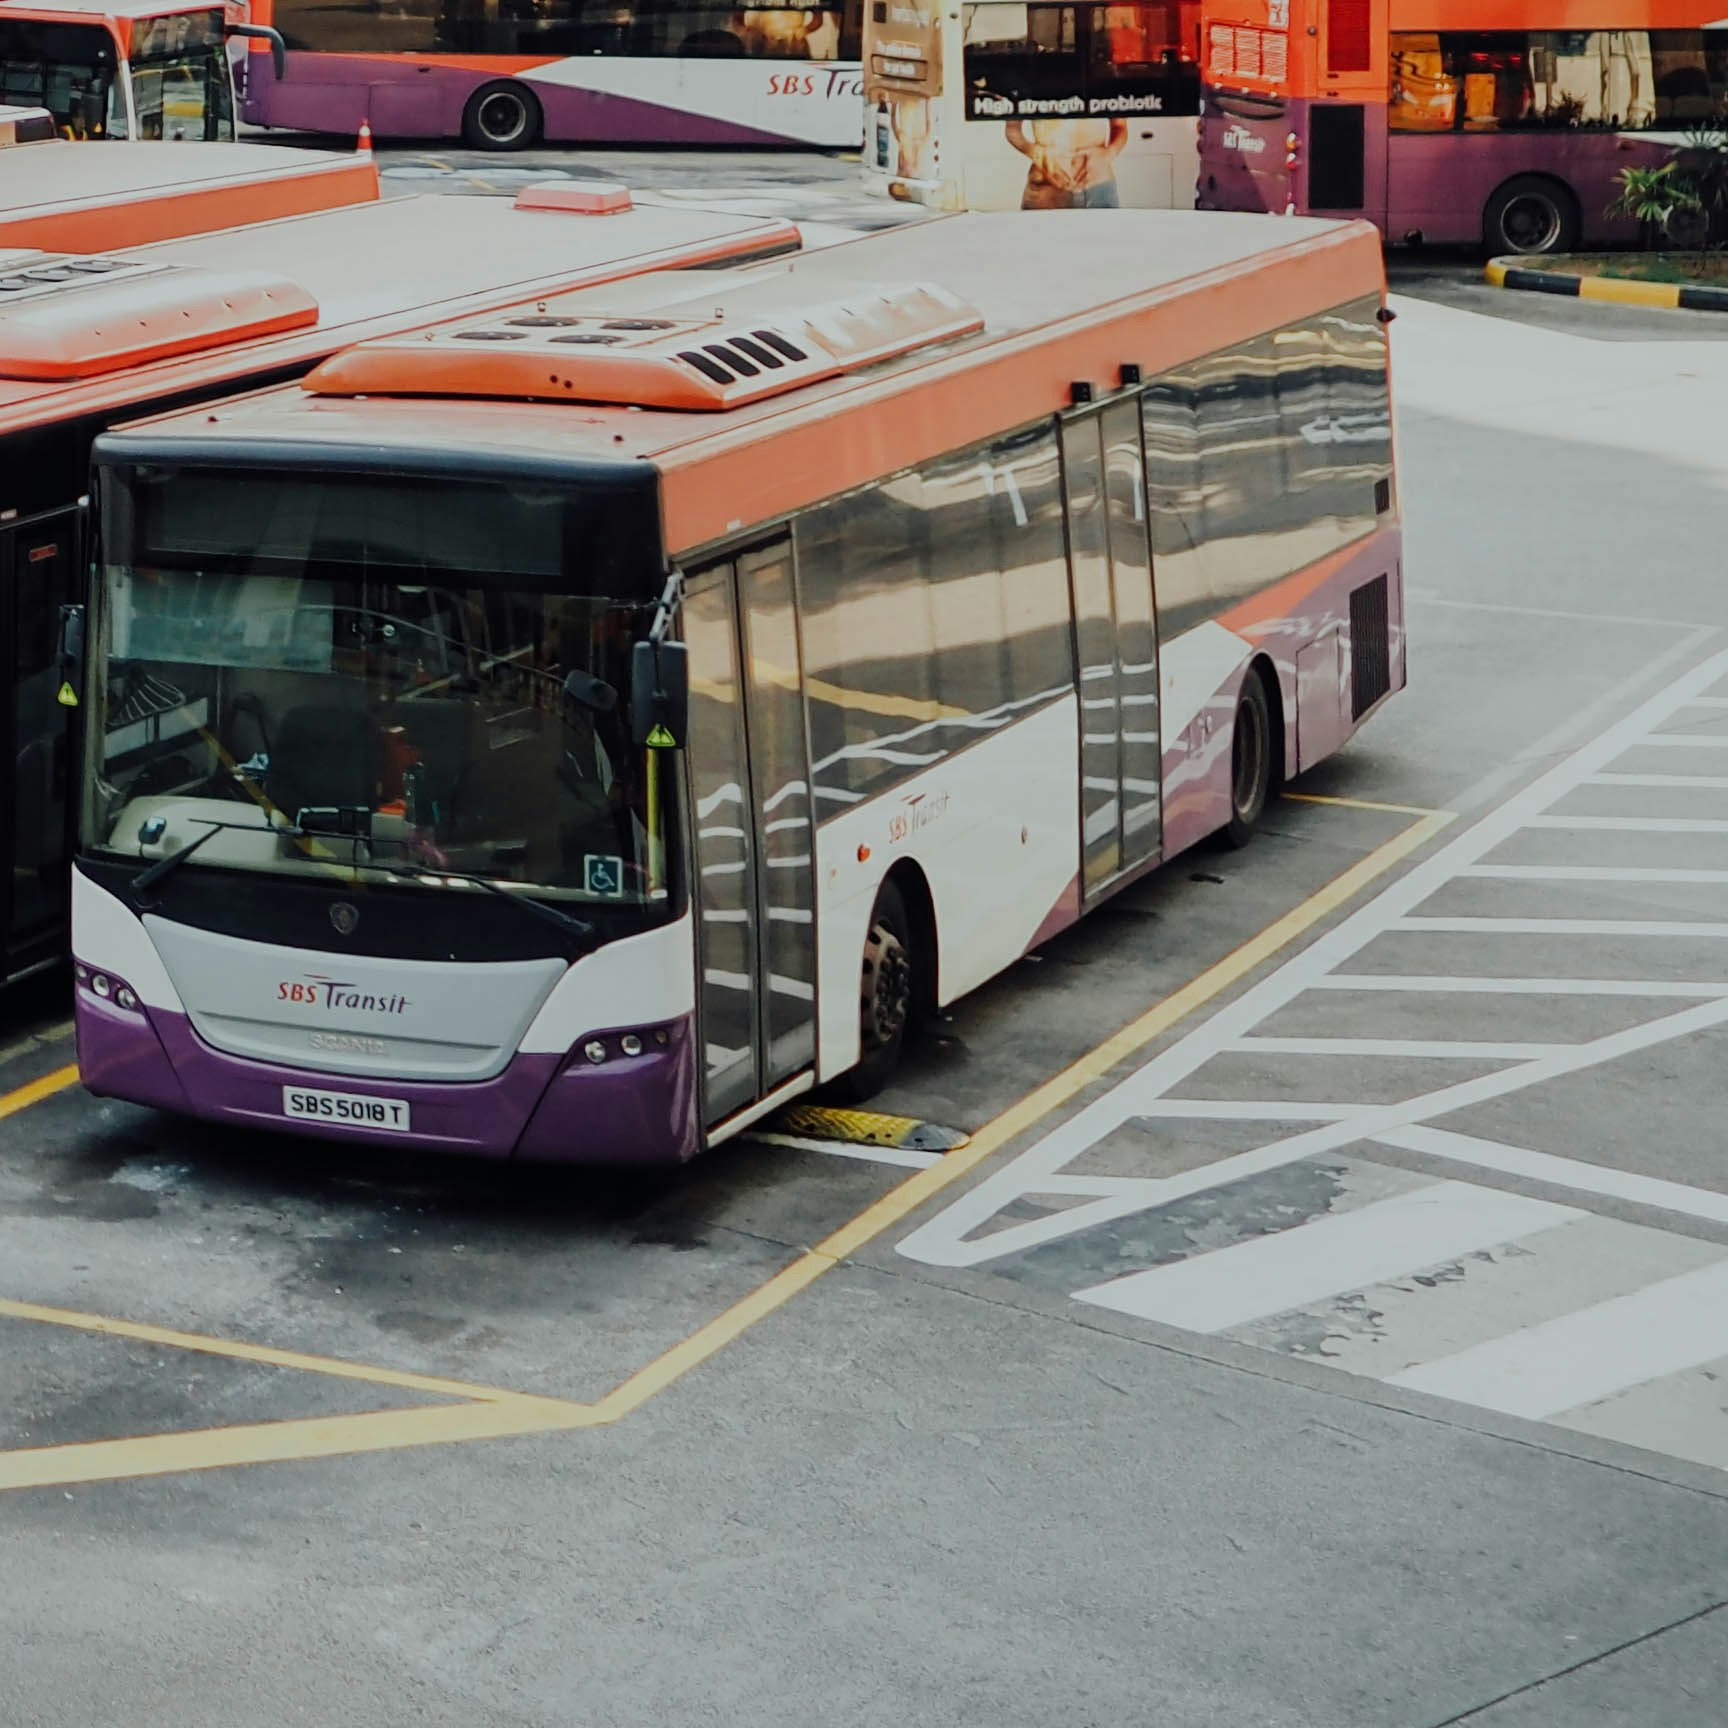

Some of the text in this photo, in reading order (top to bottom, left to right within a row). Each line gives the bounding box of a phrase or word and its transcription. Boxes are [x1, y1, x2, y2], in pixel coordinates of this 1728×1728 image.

[766, 74, 814, 95] SBS
[974, 95, 1162, 115] High strength probiotic
[277, 981, 413, 1014] SBS Transit
[291, 1094, 402, 1124] SBS5018T
